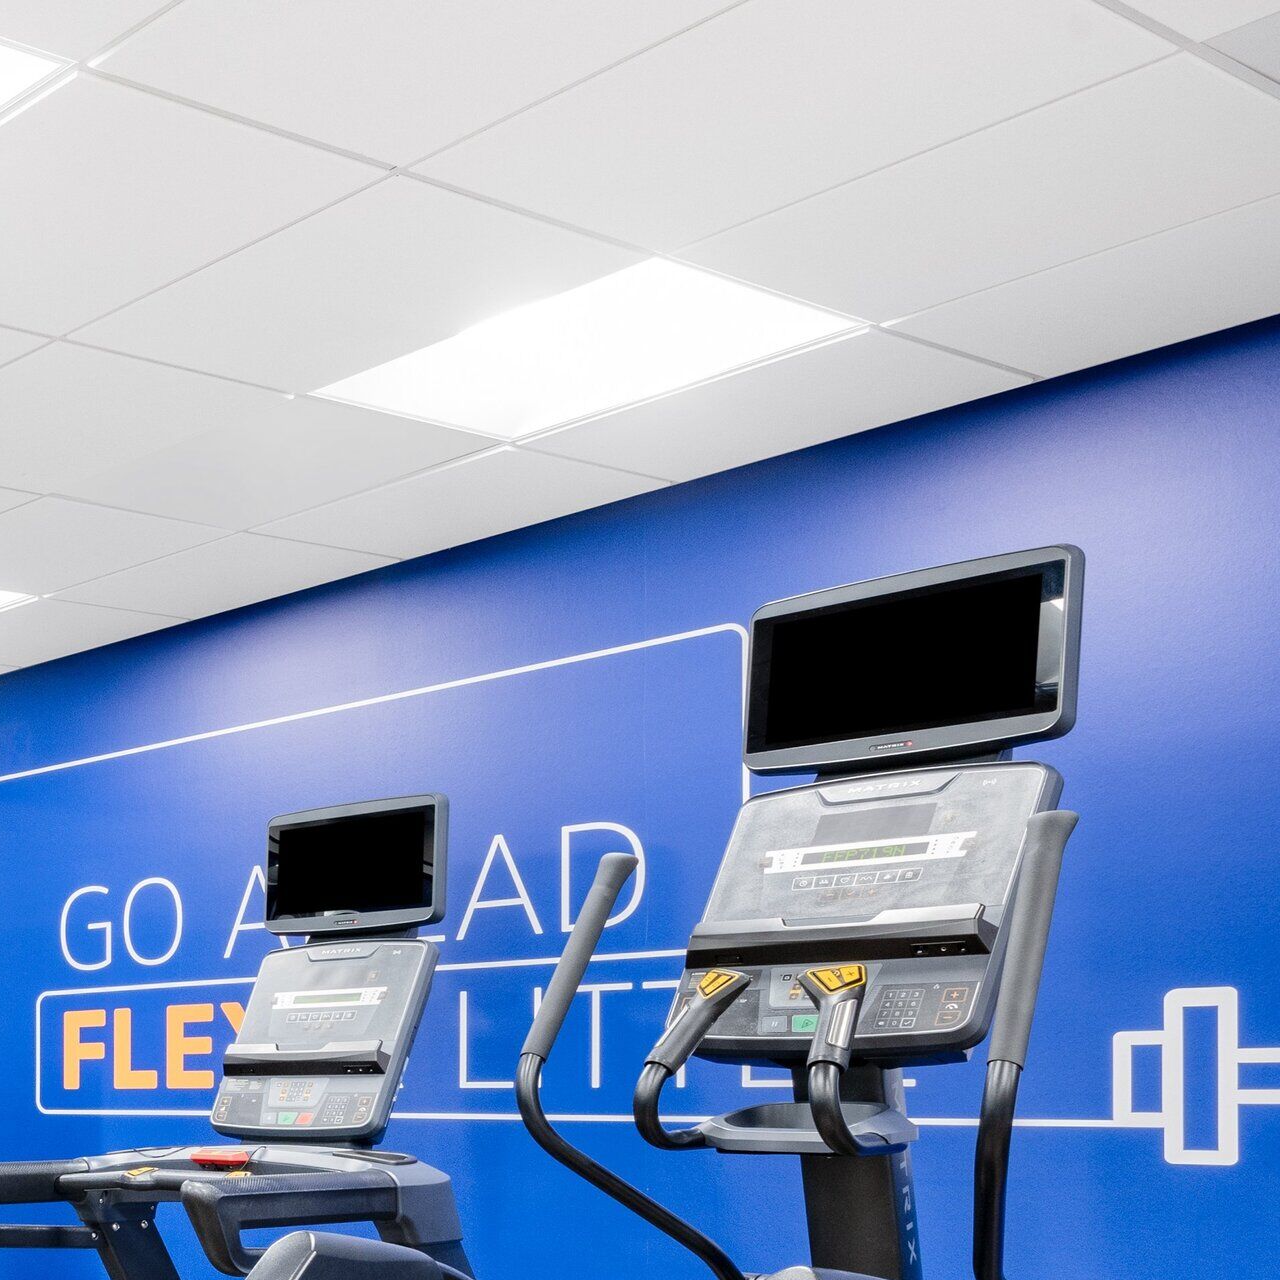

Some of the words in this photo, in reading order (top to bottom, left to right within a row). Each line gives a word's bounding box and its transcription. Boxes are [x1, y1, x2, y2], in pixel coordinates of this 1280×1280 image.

[847, 779, 922, 793] MATRIX
[60, 877, 183, 971] GO
[321, 947, 361, 955] MATRIX
